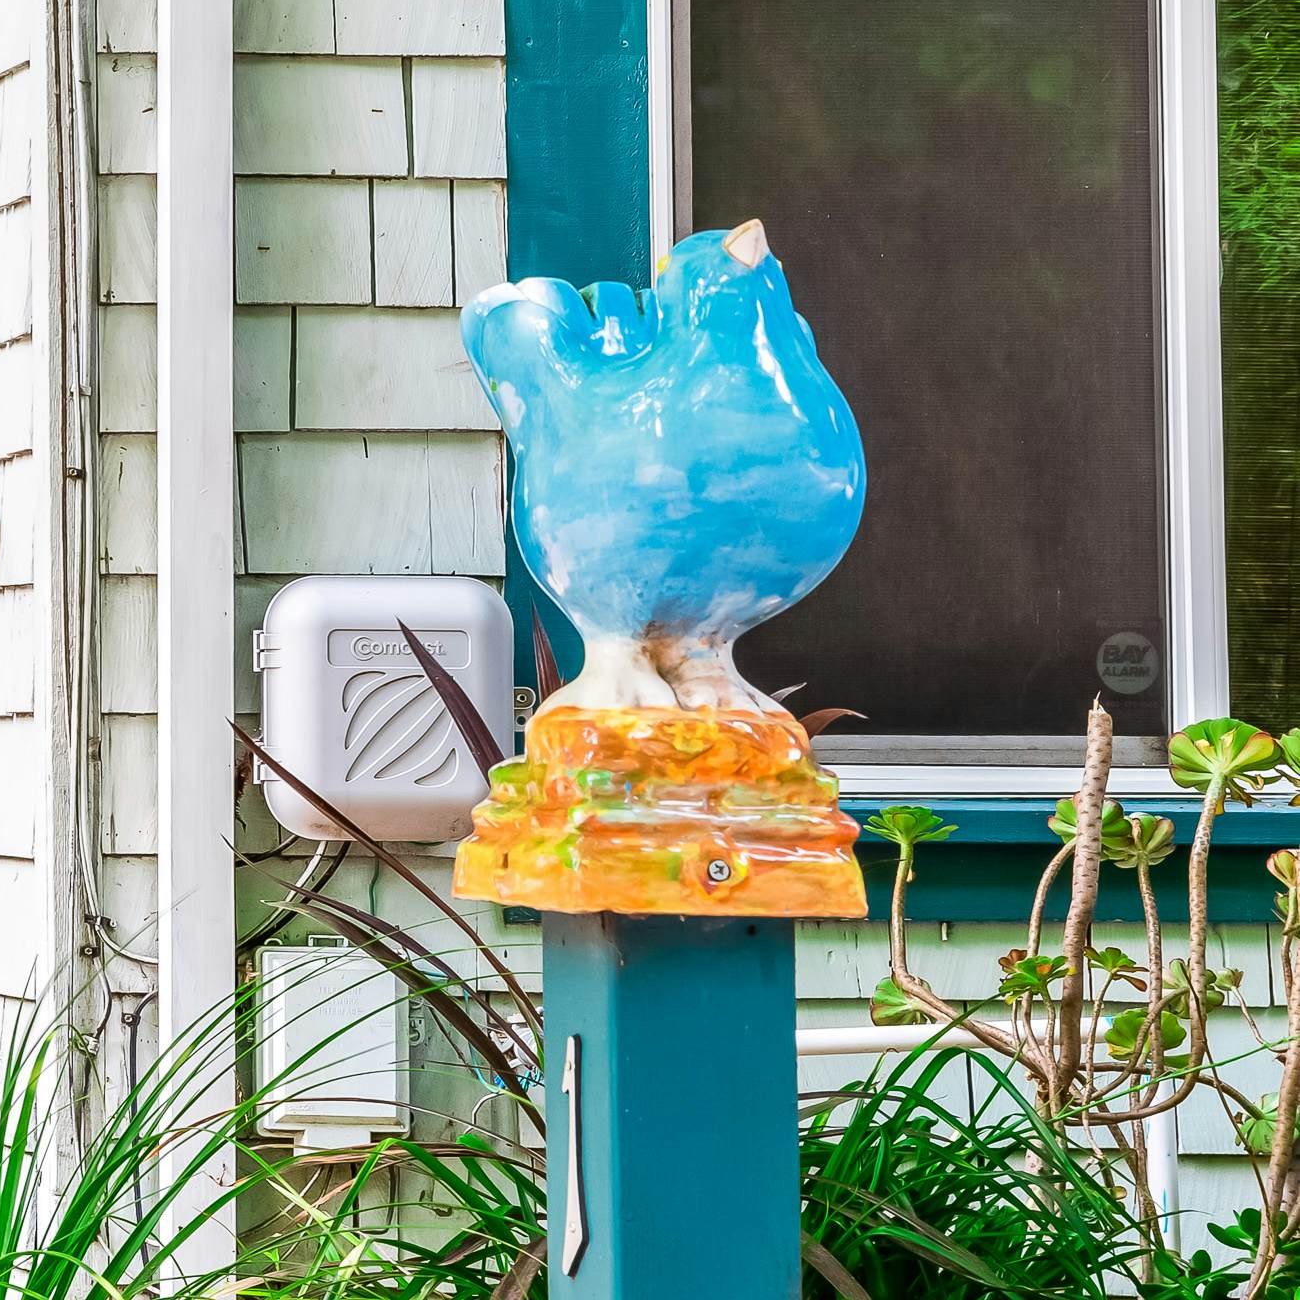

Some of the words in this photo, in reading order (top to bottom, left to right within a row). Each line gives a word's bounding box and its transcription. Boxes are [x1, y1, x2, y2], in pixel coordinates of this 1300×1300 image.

[351, 636, 444, 661] Comcst
[1103, 644, 1151, 663] BAY
[1102, 666, 1151, 677] ALARM
